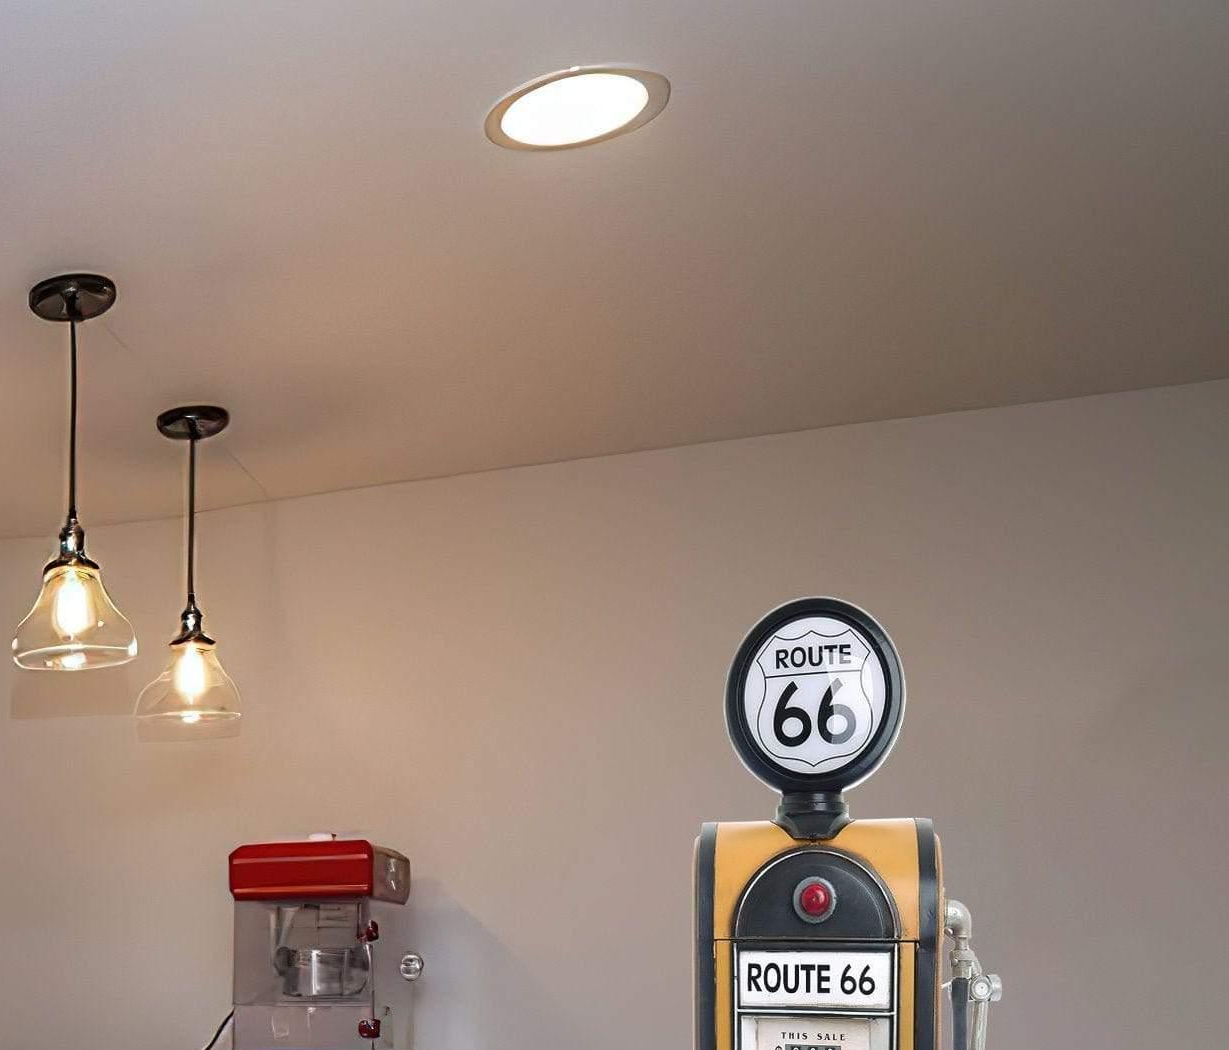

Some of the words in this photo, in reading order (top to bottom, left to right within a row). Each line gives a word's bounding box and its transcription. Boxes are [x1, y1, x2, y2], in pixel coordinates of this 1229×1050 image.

[775, 644, 852, 669] ROUTE
[773, 679, 857, 747] 66
[747, 963, 831, 994] ROUTE
[840, 964, 876, 995] 66
[781, 1031, 808, 1040] THIS
[816, 1032, 847, 1042] SALE
